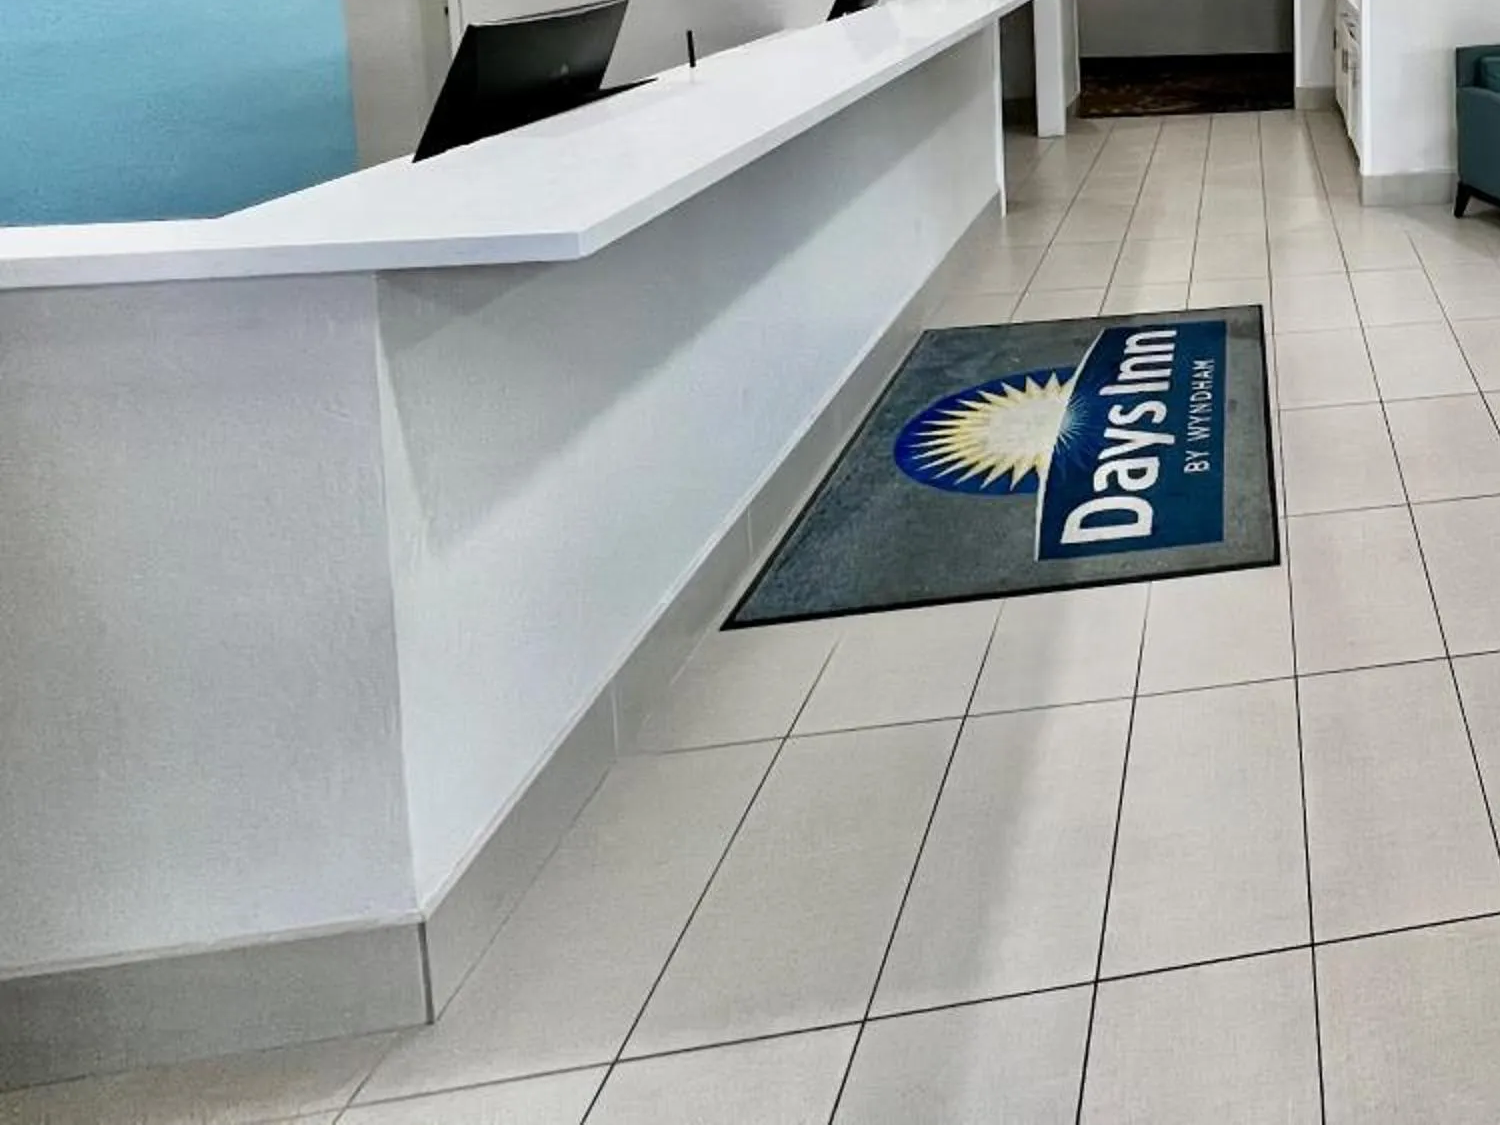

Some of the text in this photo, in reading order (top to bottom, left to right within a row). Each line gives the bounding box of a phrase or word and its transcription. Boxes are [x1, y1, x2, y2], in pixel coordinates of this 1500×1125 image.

[1060, 330, 1177, 544] Days Inn
[1184, 359, 1216, 473] BY WYNDHAM
